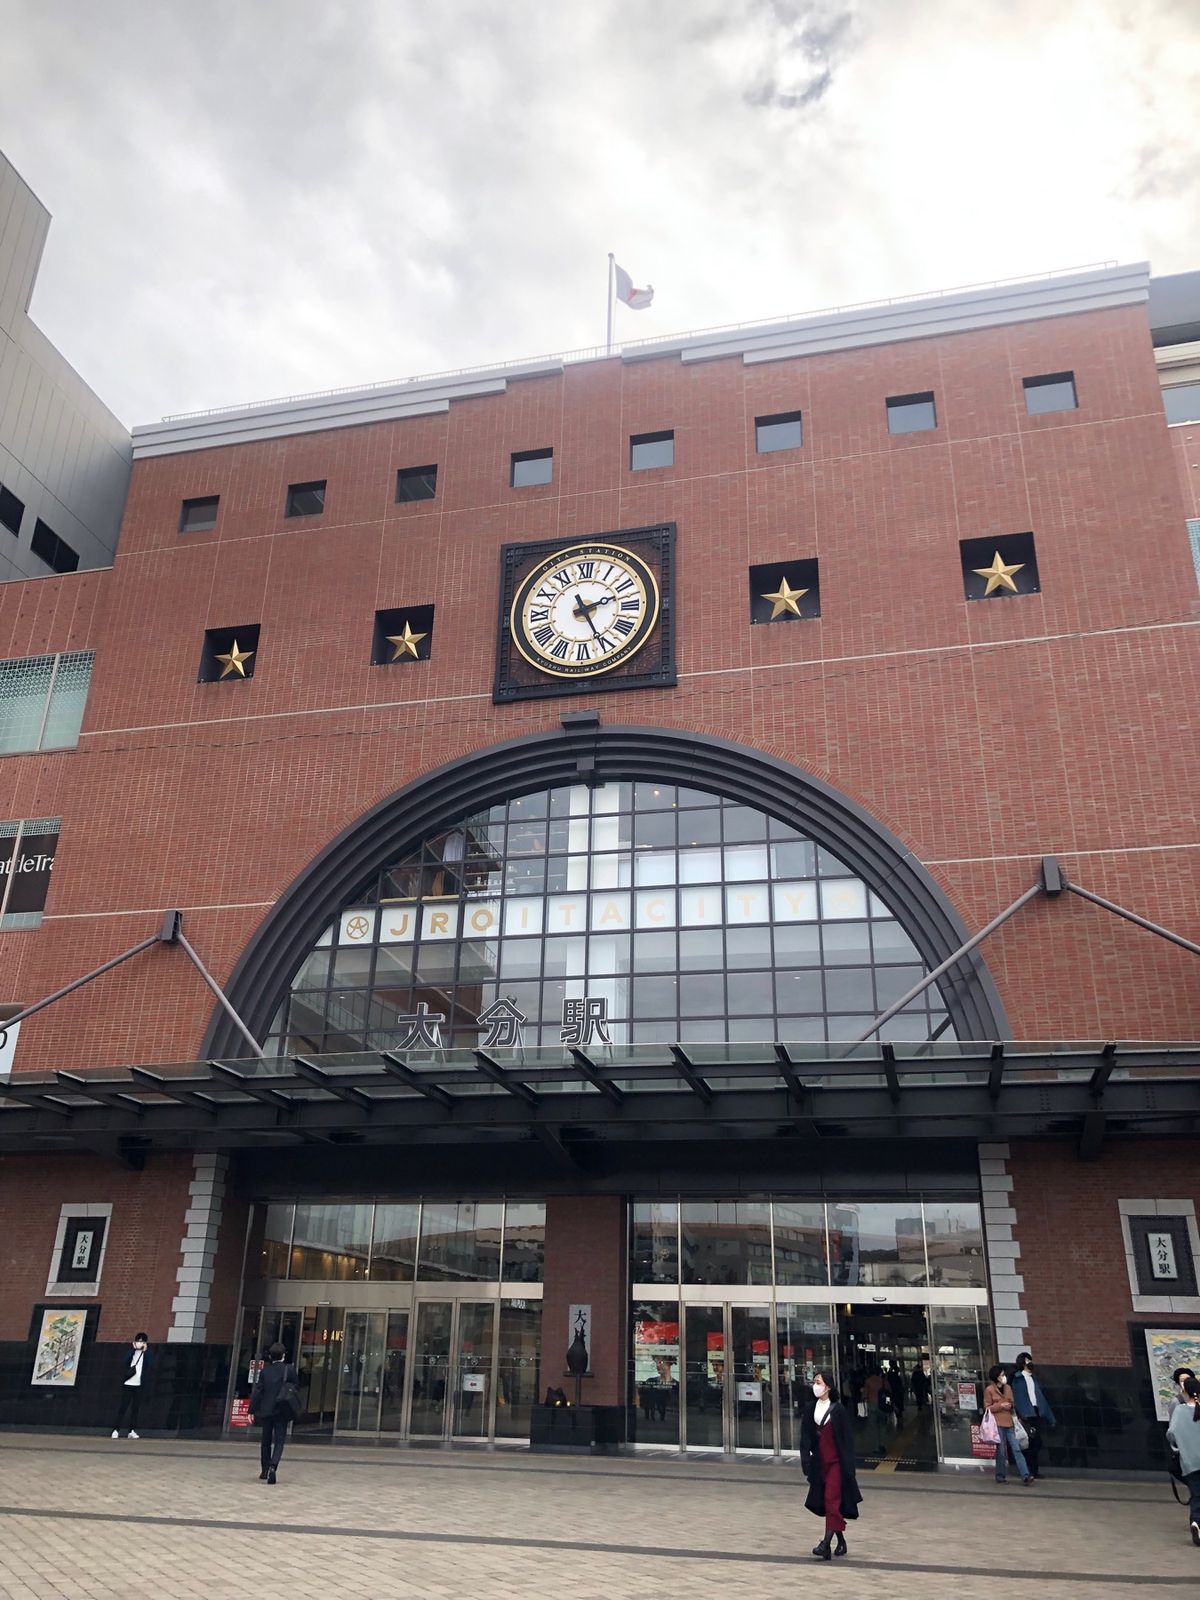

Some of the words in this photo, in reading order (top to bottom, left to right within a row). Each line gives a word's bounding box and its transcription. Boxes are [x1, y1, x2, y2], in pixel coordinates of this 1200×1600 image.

[543, 554, 569, 571] OITA
[580, 549, 630, 561] STATION
[552, 569, 571, 587] XI
[577, 562, 595, 579] XII
[537, 588, 556, 601] X
[615, 578, 634, 593] II
[621, 599, 640, 611] III
[530, 609, 549, 622] IX
[537, 657, 561, 671] KYUSHU
[603, 646, 632, 666] COMPANY
[396, 998, 613, 1050] 大分駅
[76, 1234, 89, 1265] 大分駅
[1156, 1236, 1171, 1274] 大分駅
